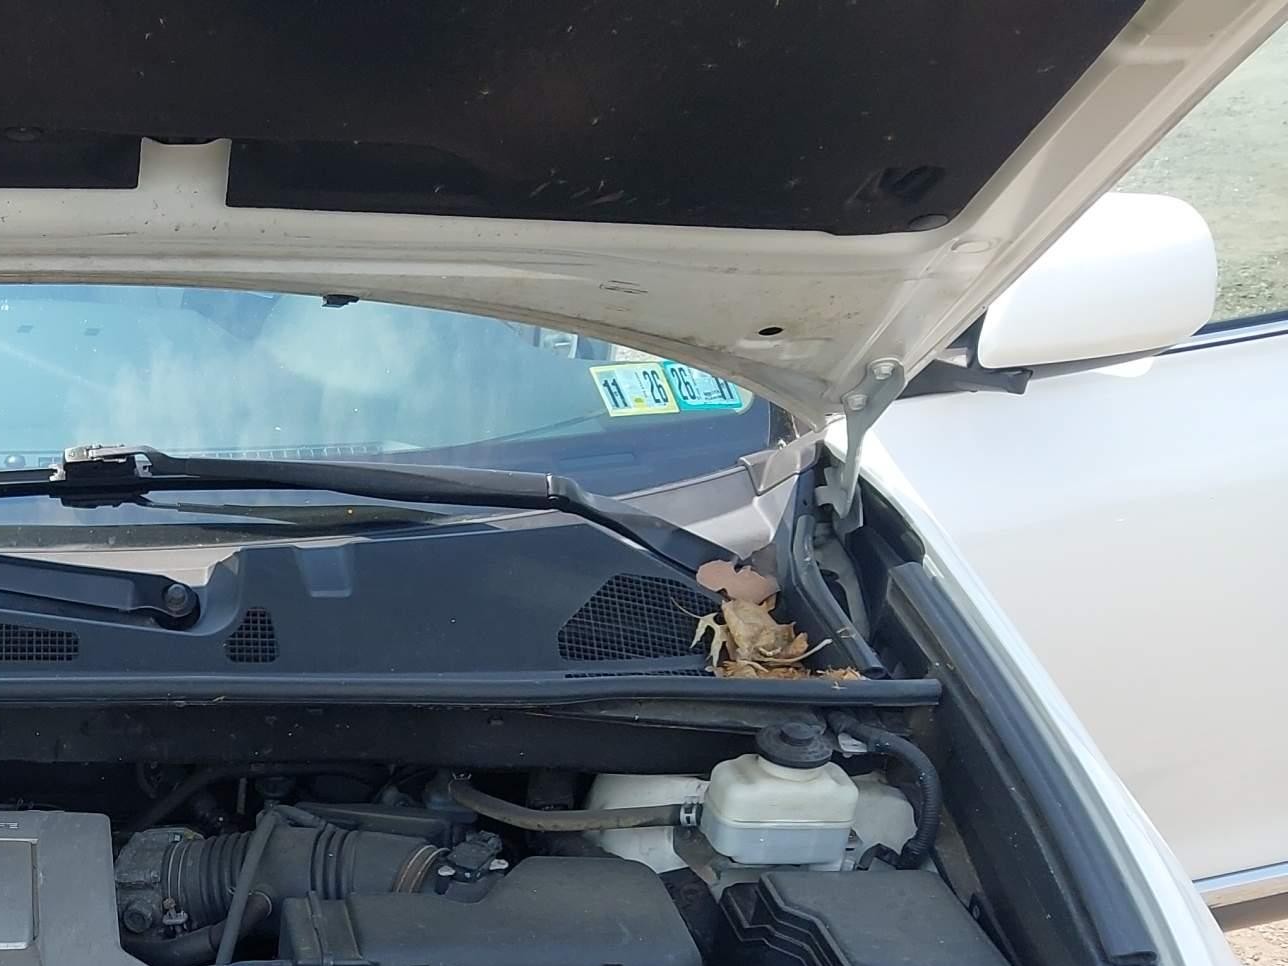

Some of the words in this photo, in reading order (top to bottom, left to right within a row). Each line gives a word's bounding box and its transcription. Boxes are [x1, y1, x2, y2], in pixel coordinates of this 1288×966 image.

[602, 379, 628, 408] 11
[643, 370, 669, 404] 26
[672, 367, 697, 401] 26
